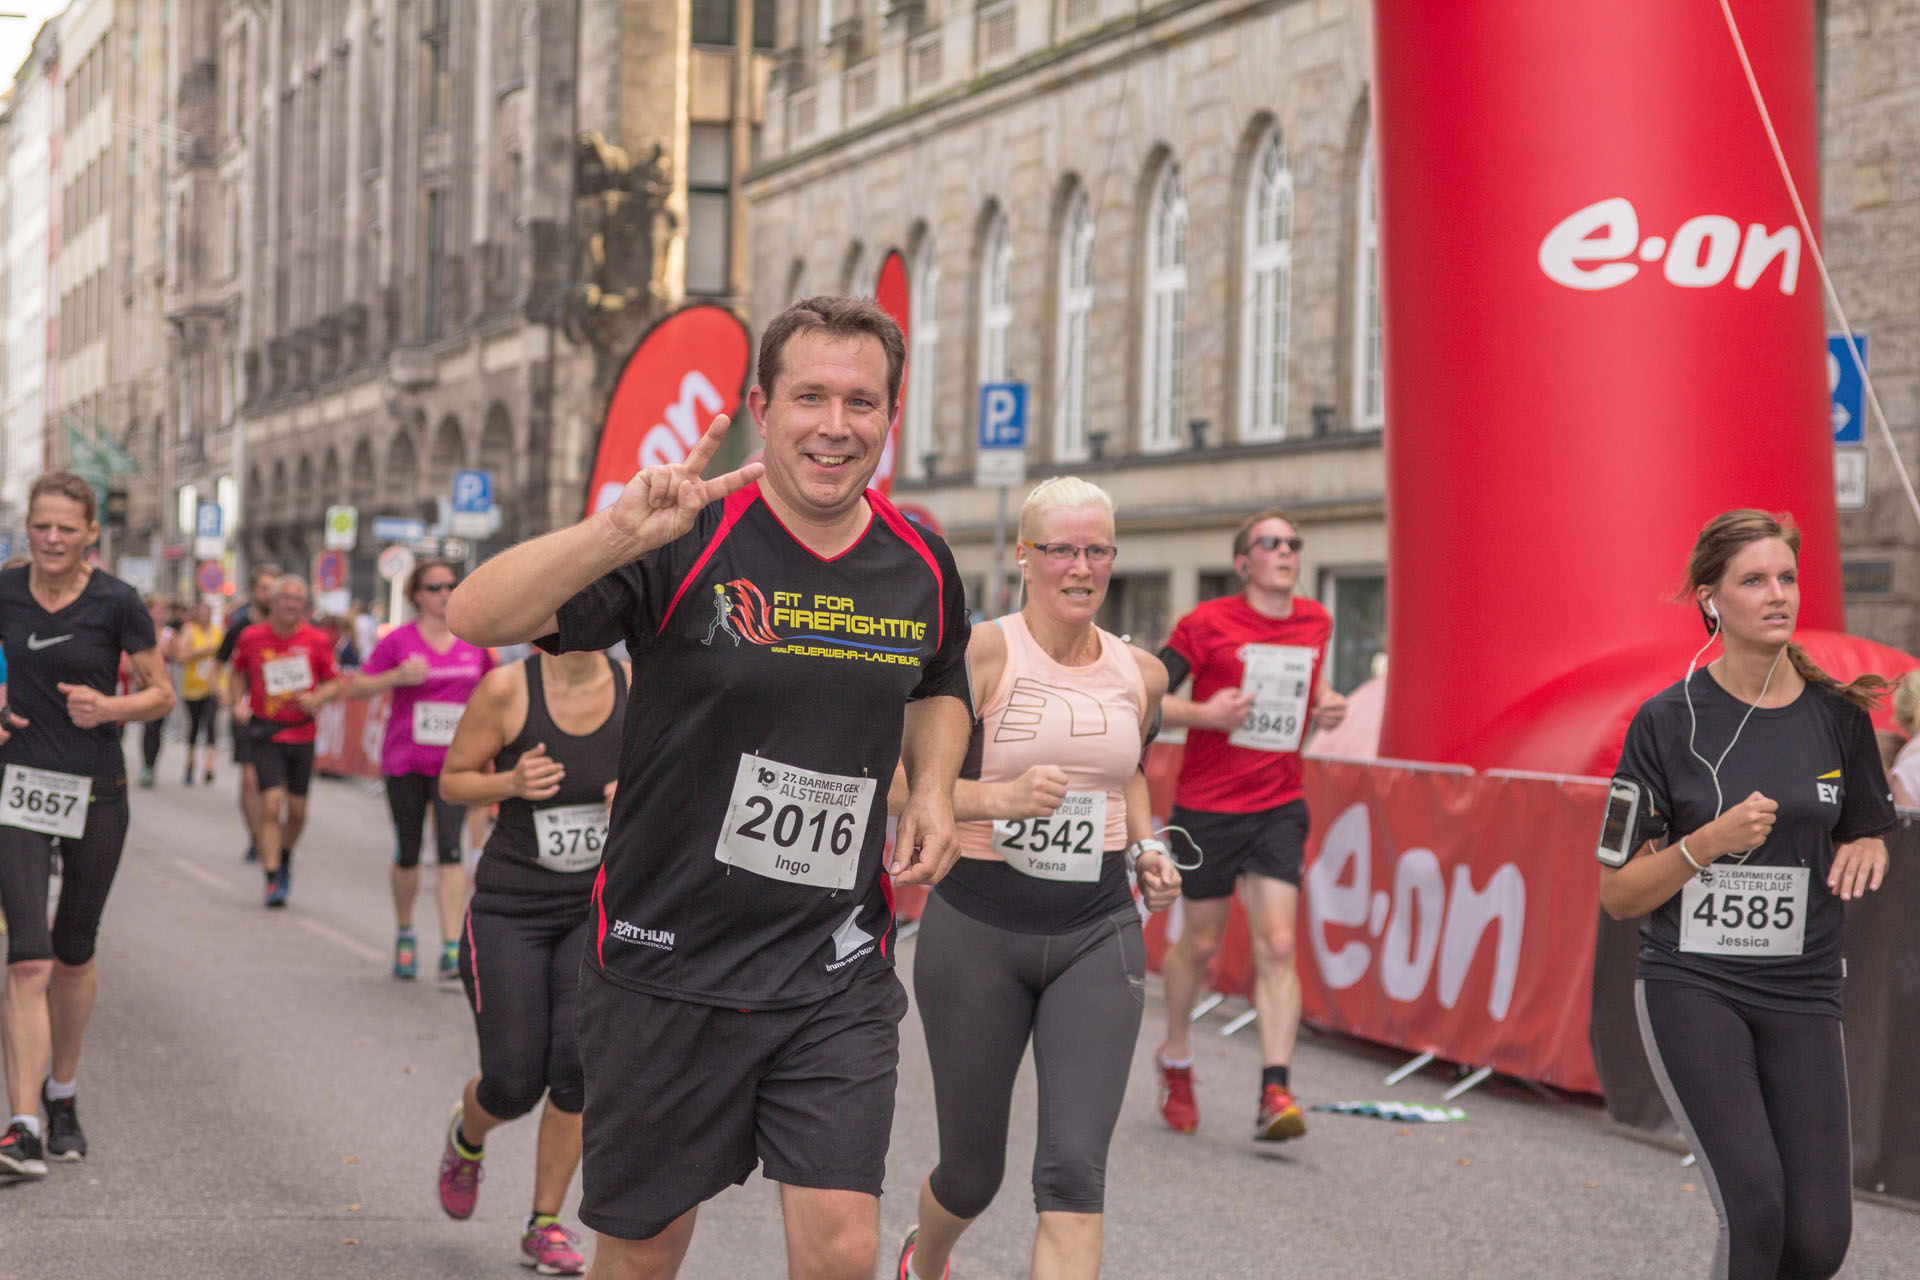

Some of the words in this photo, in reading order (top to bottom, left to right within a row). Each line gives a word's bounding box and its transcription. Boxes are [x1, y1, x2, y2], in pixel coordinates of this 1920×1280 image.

[985, 389, 1017, 441] P
[773, 591, 802, 607] FIT
[814, 594, 854, 612] FOR
[773, 607, 927, 641] FIREFIGHTING
[1243, 711, 1297, 736] 3949
[757, 766, 776, 785] 10
[782, 771, 797, 785] 27.
[799, 776, 842, 792] BARMER
[843, 783, 860, 794] GEK
[9, 786, 78, 818] 3657
[779, 784, 857, 808] ALSTERLAUF
[1816, 782, 1839, 804] EY
[736, 795, 856, 856] 2016
[1001, 819, 1094, 855] 2542
[775, 854, 811, 876] Ingo
[1028, 857, 1066, 872] Yasna
[1732, 870, 1773, 880] BARMER
[1774, 872, 1793, 881] GEK
[1719, 880, 1793, 892] ALSTERLAUF
[1693, 892, 1795, 930] 4585
[1717, 934, 1769, 948] Jessica
